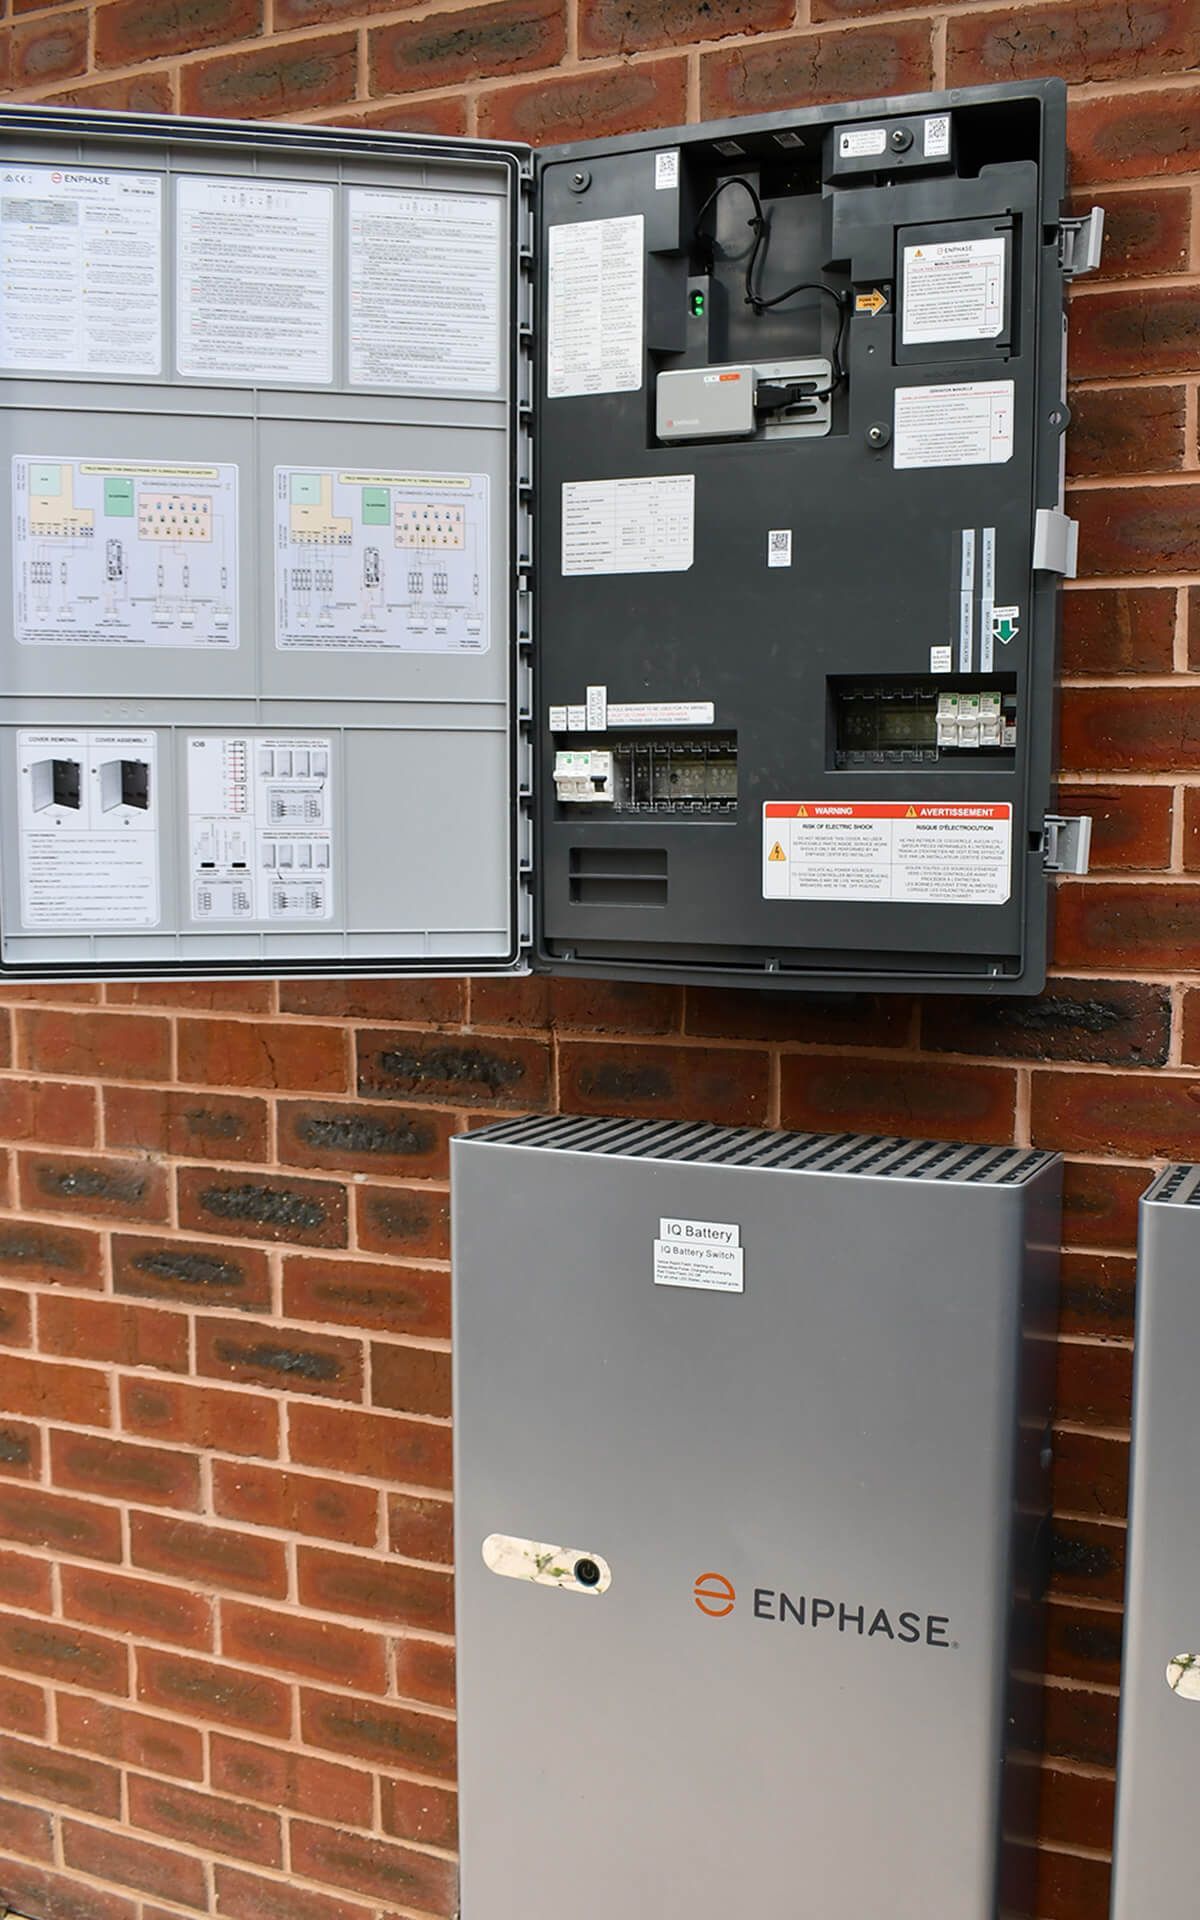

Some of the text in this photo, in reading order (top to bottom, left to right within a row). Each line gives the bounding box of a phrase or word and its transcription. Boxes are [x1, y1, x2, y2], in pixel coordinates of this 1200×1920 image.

[64, 174, 111, 185] ENPHASE
[944, 245, 972, 254] ENPHASE
[815, 807, 854, 815] WARNING
[920, 808, 995, 816] AVERTISSEMENT
[667, 1224, 733, 1243] IQ Battery
[661, 1245, 735, 1260] IQ Battery Switch
[753, 1588, 951, 1648] ENPHASE
